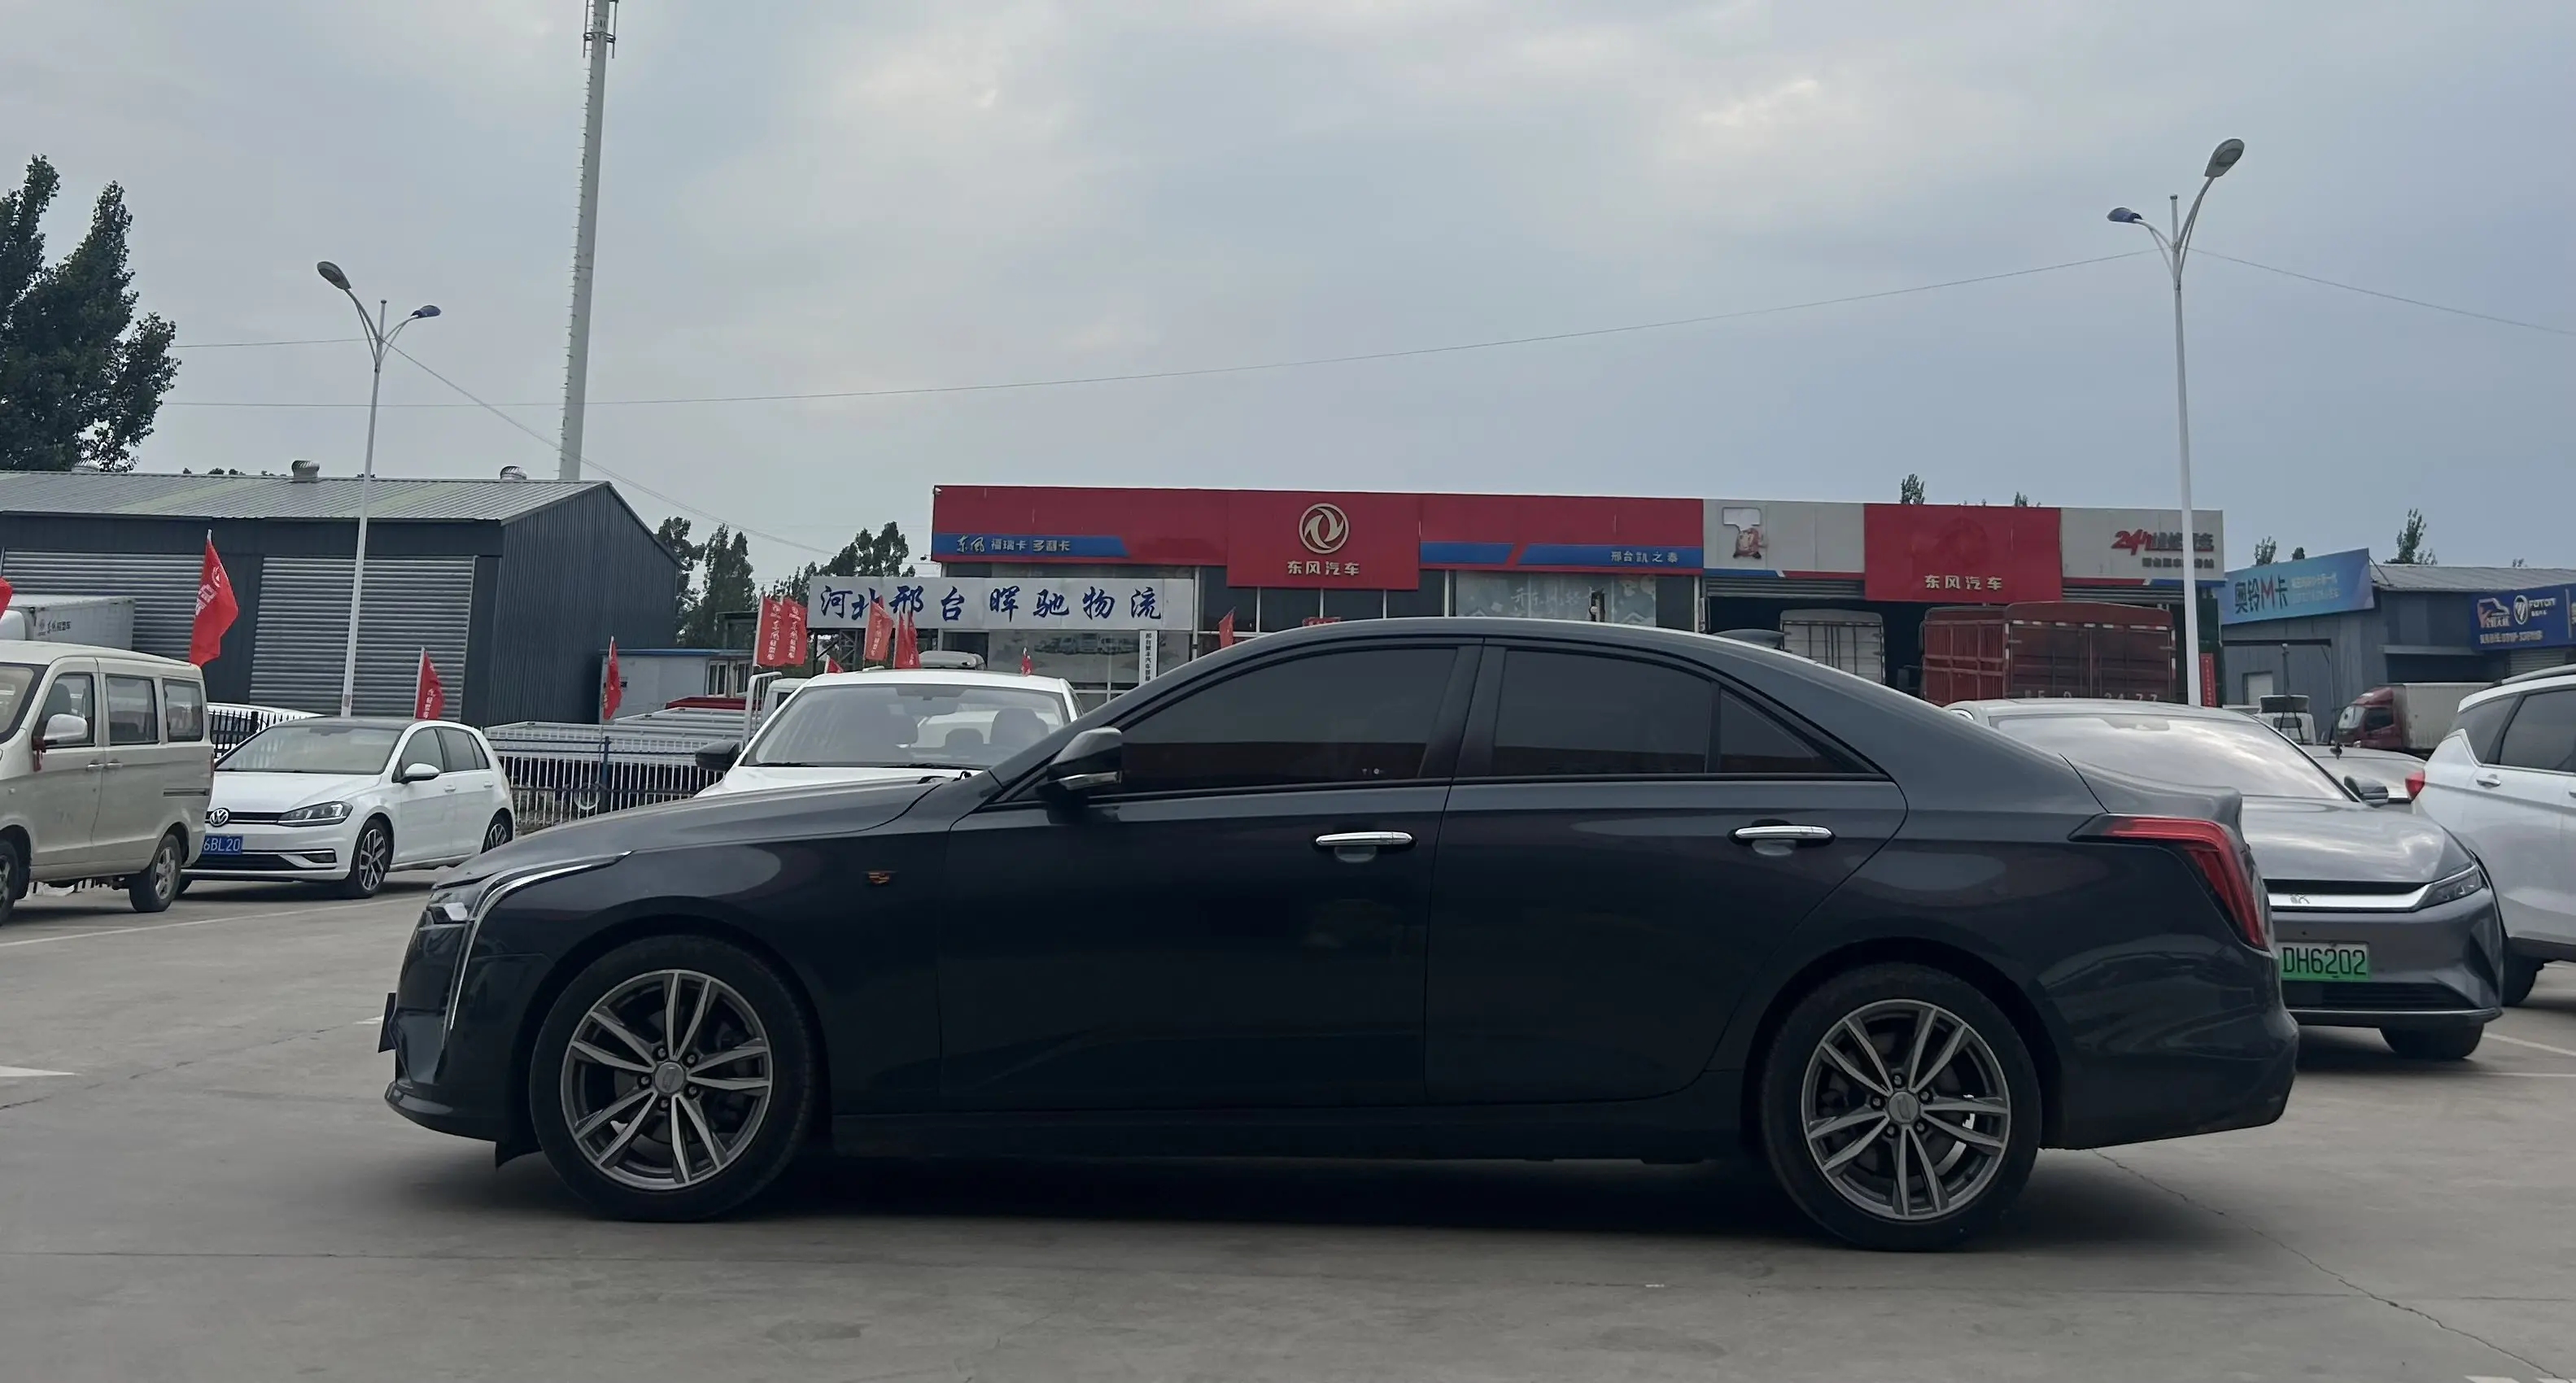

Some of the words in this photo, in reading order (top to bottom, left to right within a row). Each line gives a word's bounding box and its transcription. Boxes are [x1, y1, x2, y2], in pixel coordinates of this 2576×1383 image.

[956, 535, 985, 552] 东风
[991, 538, 1027, 551] 福瑞卡
[1287, 561, 1360, 576] 东风汽车
[1924, 574, 2002, 591] 东风汽车
[2235, 574, 2288, 614] 奥铃M卡
[2282, 947, 2367, 975] DH6202
